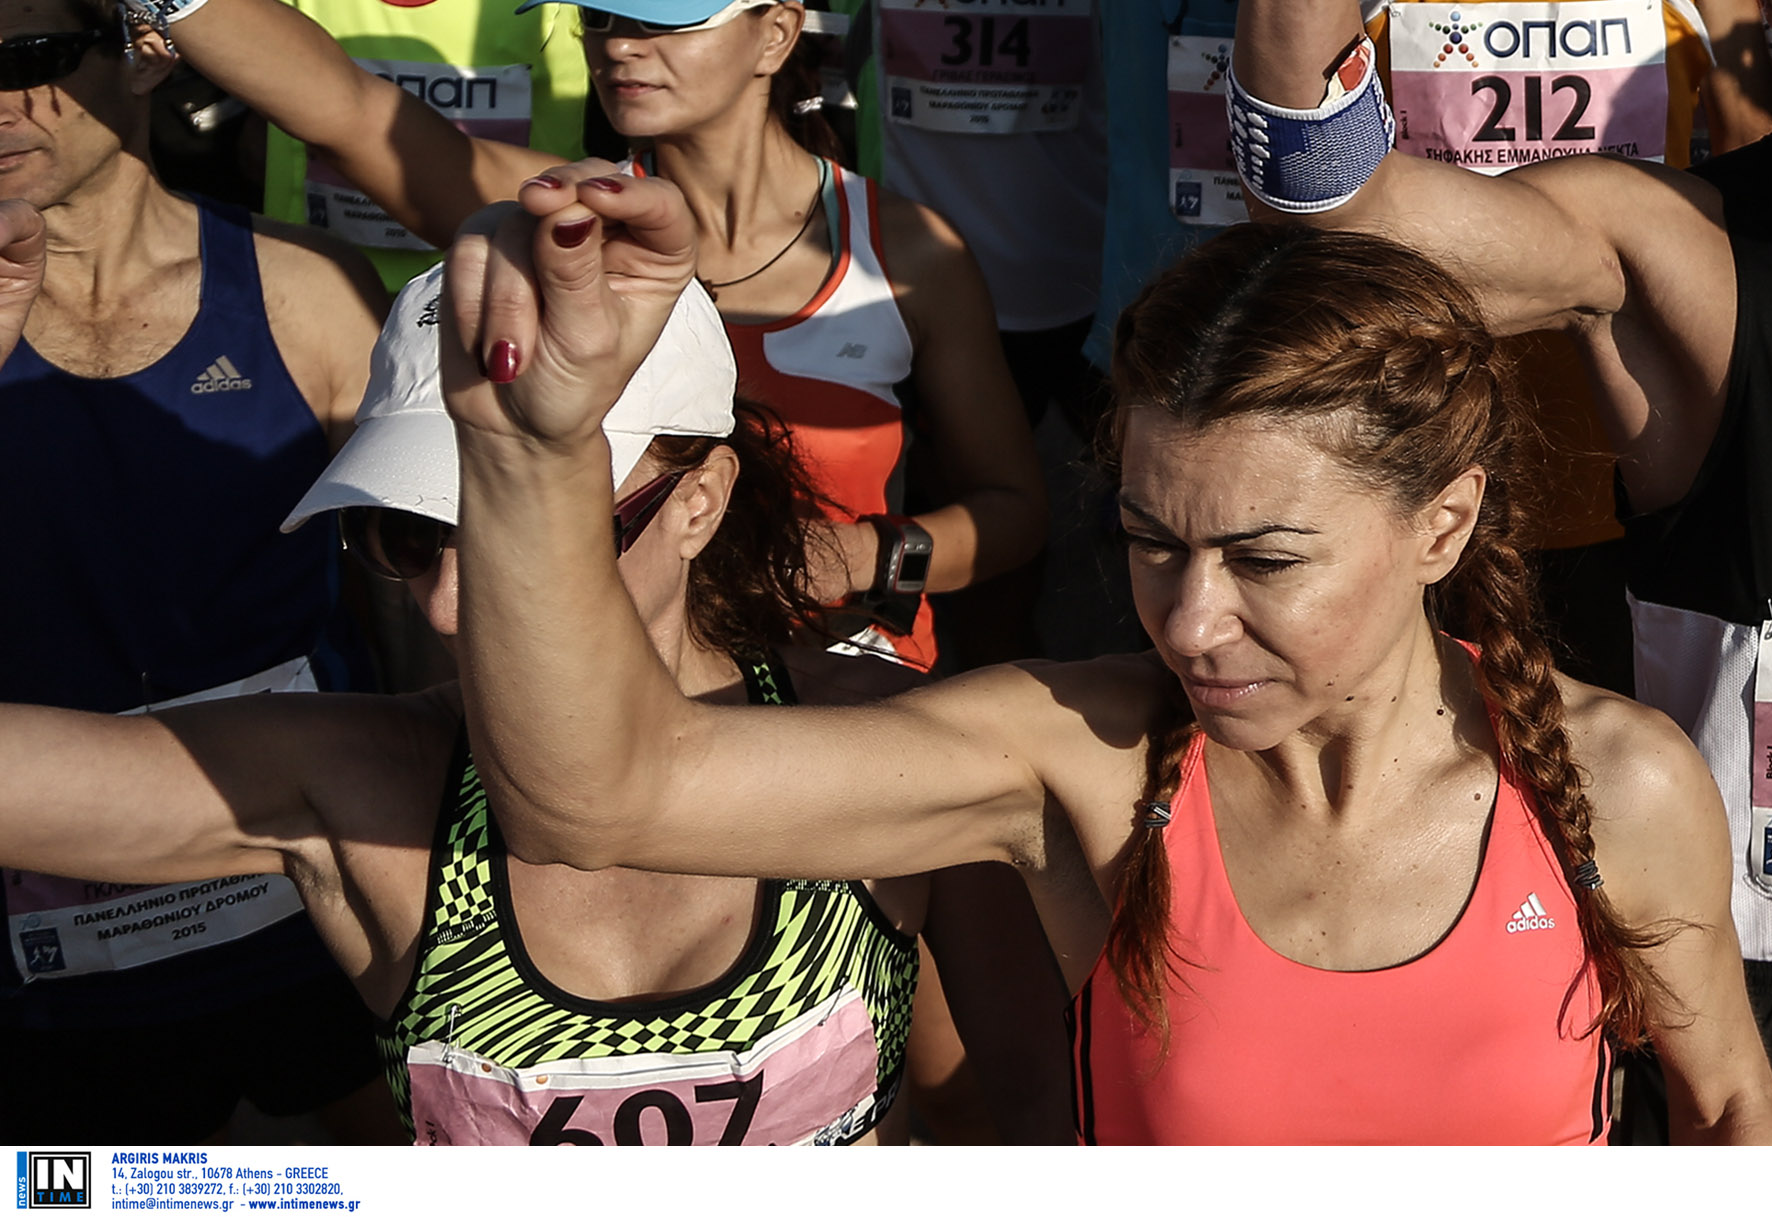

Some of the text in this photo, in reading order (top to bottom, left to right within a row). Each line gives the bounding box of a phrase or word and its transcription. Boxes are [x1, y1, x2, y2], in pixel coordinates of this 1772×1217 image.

[940, 15, 1032, 68] 314
[1470, 74, 1596, 143] 212
[190, 378, 253, 394] adidas
[73, 893, 177, 927] ΠΑΝΕΛΛΗΝΙΟ
[96, 882, 270, 941] ΜΑΡΑΘΩΝΙΟΥ ΔΡΟΜΟΥ
[1505, 914, 1556, 934] adidas
[171, 921, 208, 941] 2015
